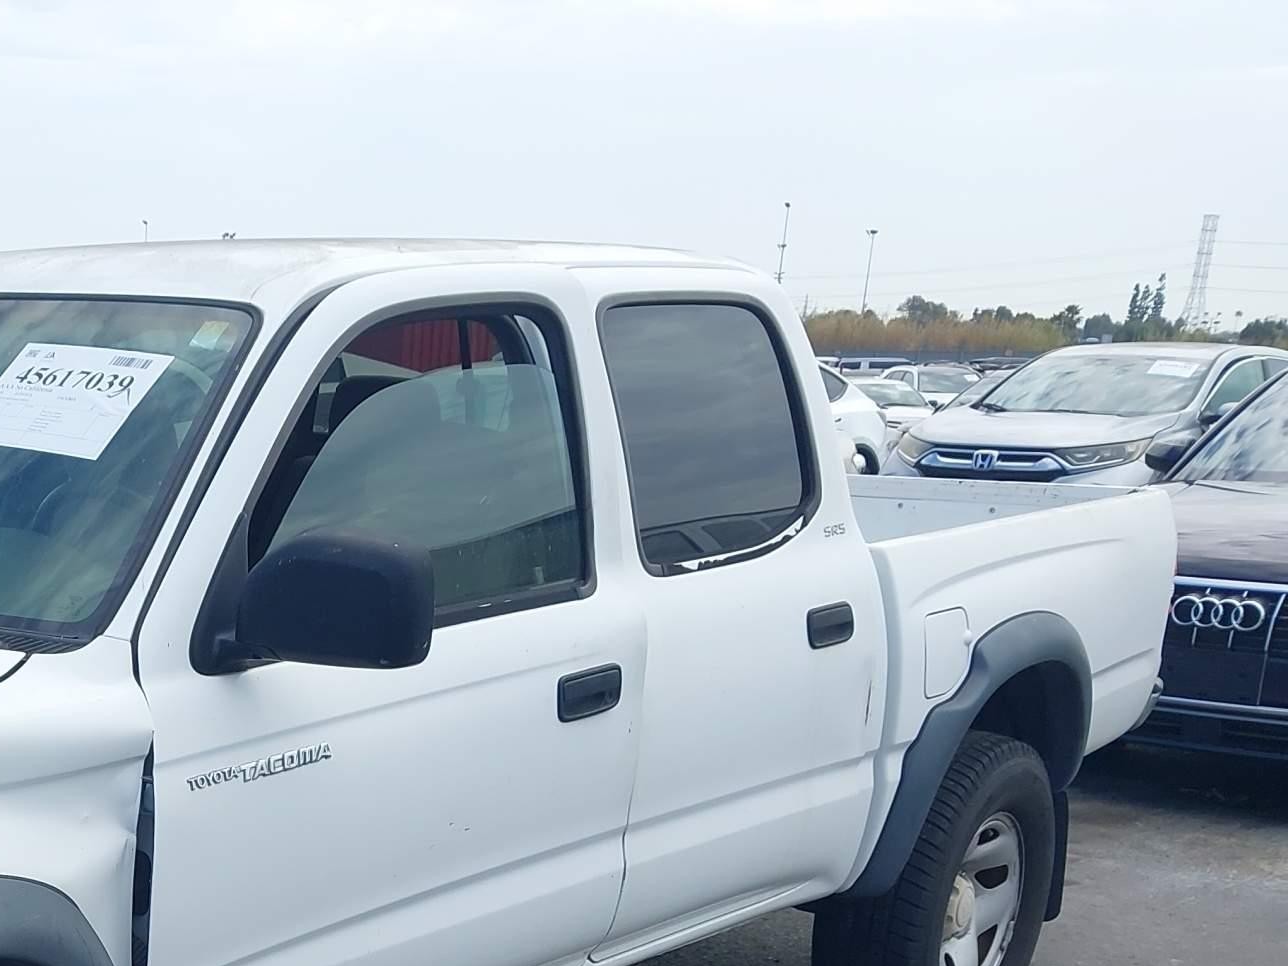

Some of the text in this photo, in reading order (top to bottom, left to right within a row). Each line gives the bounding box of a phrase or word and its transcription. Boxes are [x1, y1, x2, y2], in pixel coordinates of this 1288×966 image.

[15, 366, 136, 394] 45617039
[186, 742, 333, 792] TOYOTA TACOMA
